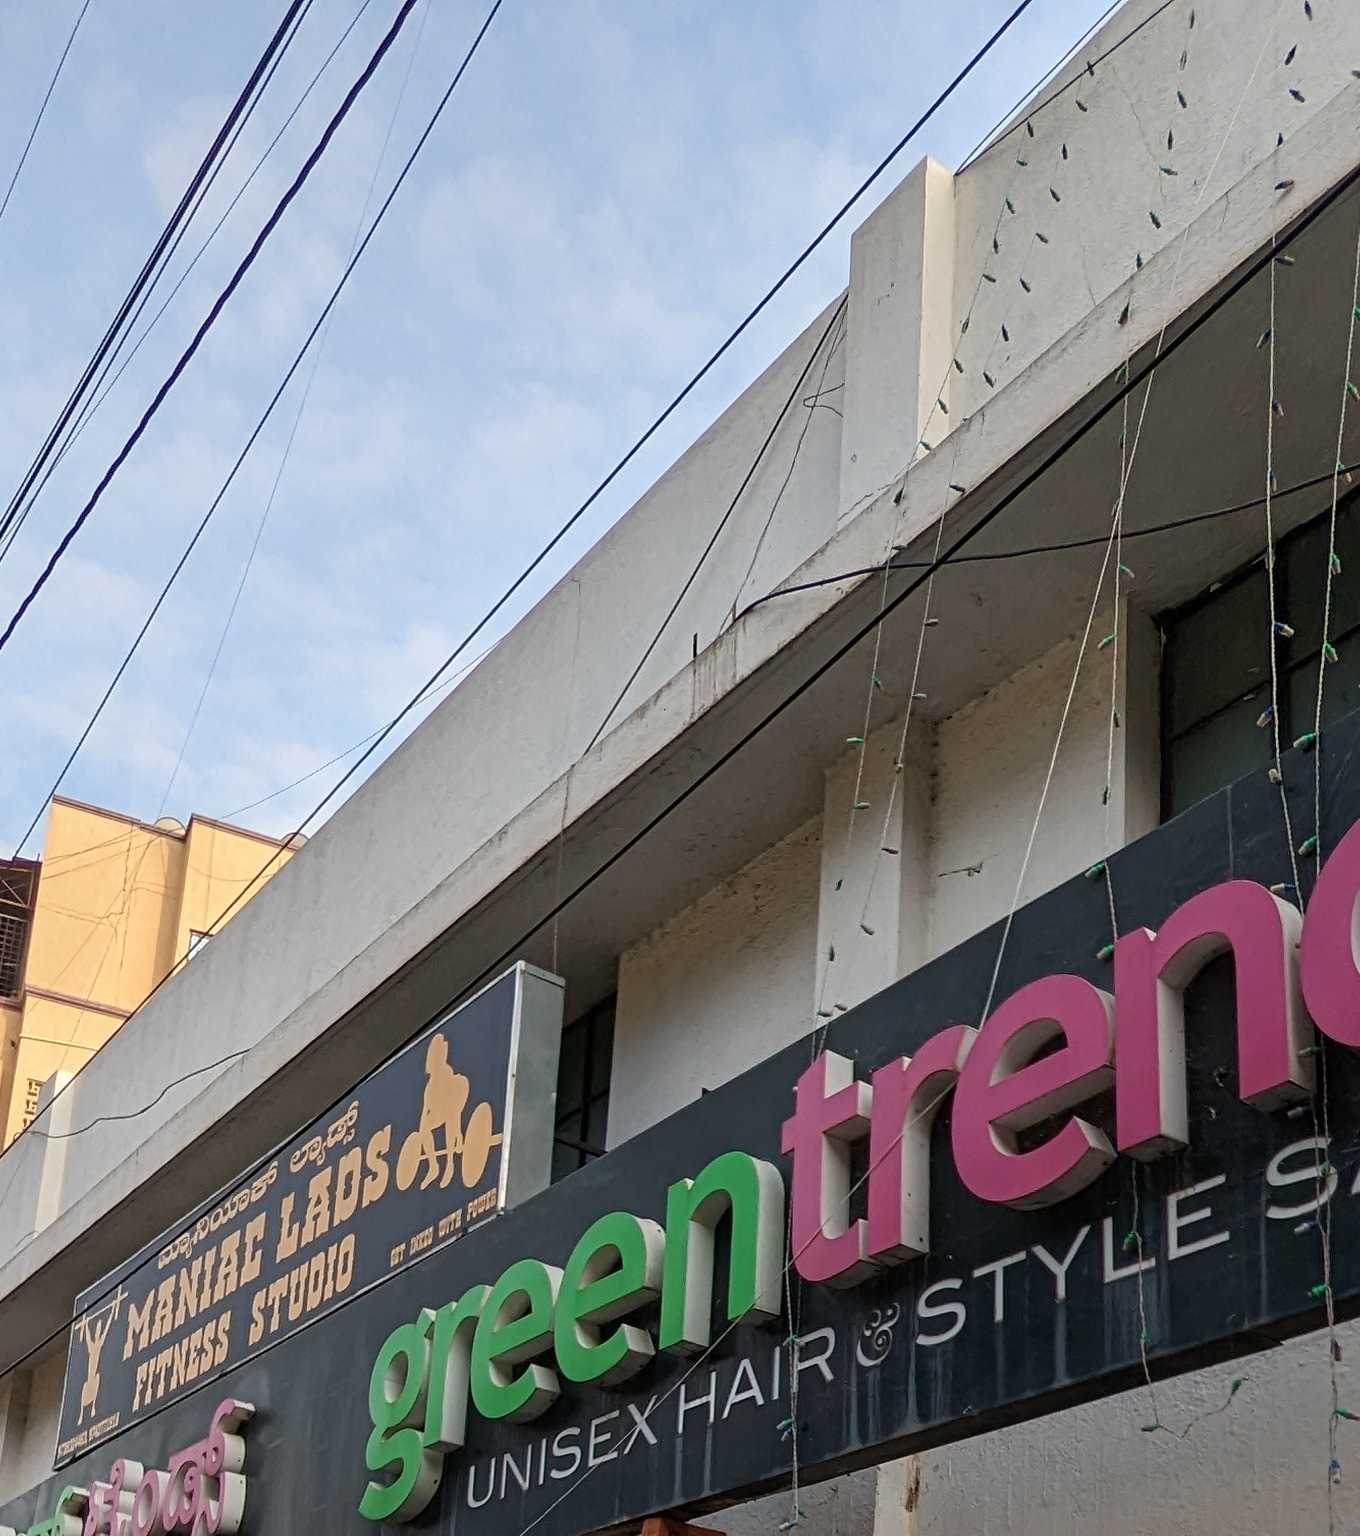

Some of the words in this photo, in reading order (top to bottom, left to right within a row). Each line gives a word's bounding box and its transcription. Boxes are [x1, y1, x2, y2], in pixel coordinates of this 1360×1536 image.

[122, 1211, 266, 1361] MANIAC
[276, 1125, 391, 1264] LADS
[132, 1310, 232, 1413] FITNESS
[247, 1233, 356, 1346] STUDIO
[466, 1398, 659, 1508] UNISEX
[676, 1326, 836, 1434] HAIR
[856, 1301, 901, 1366] &
[915, 1173, 1230, 1347] STYLE
